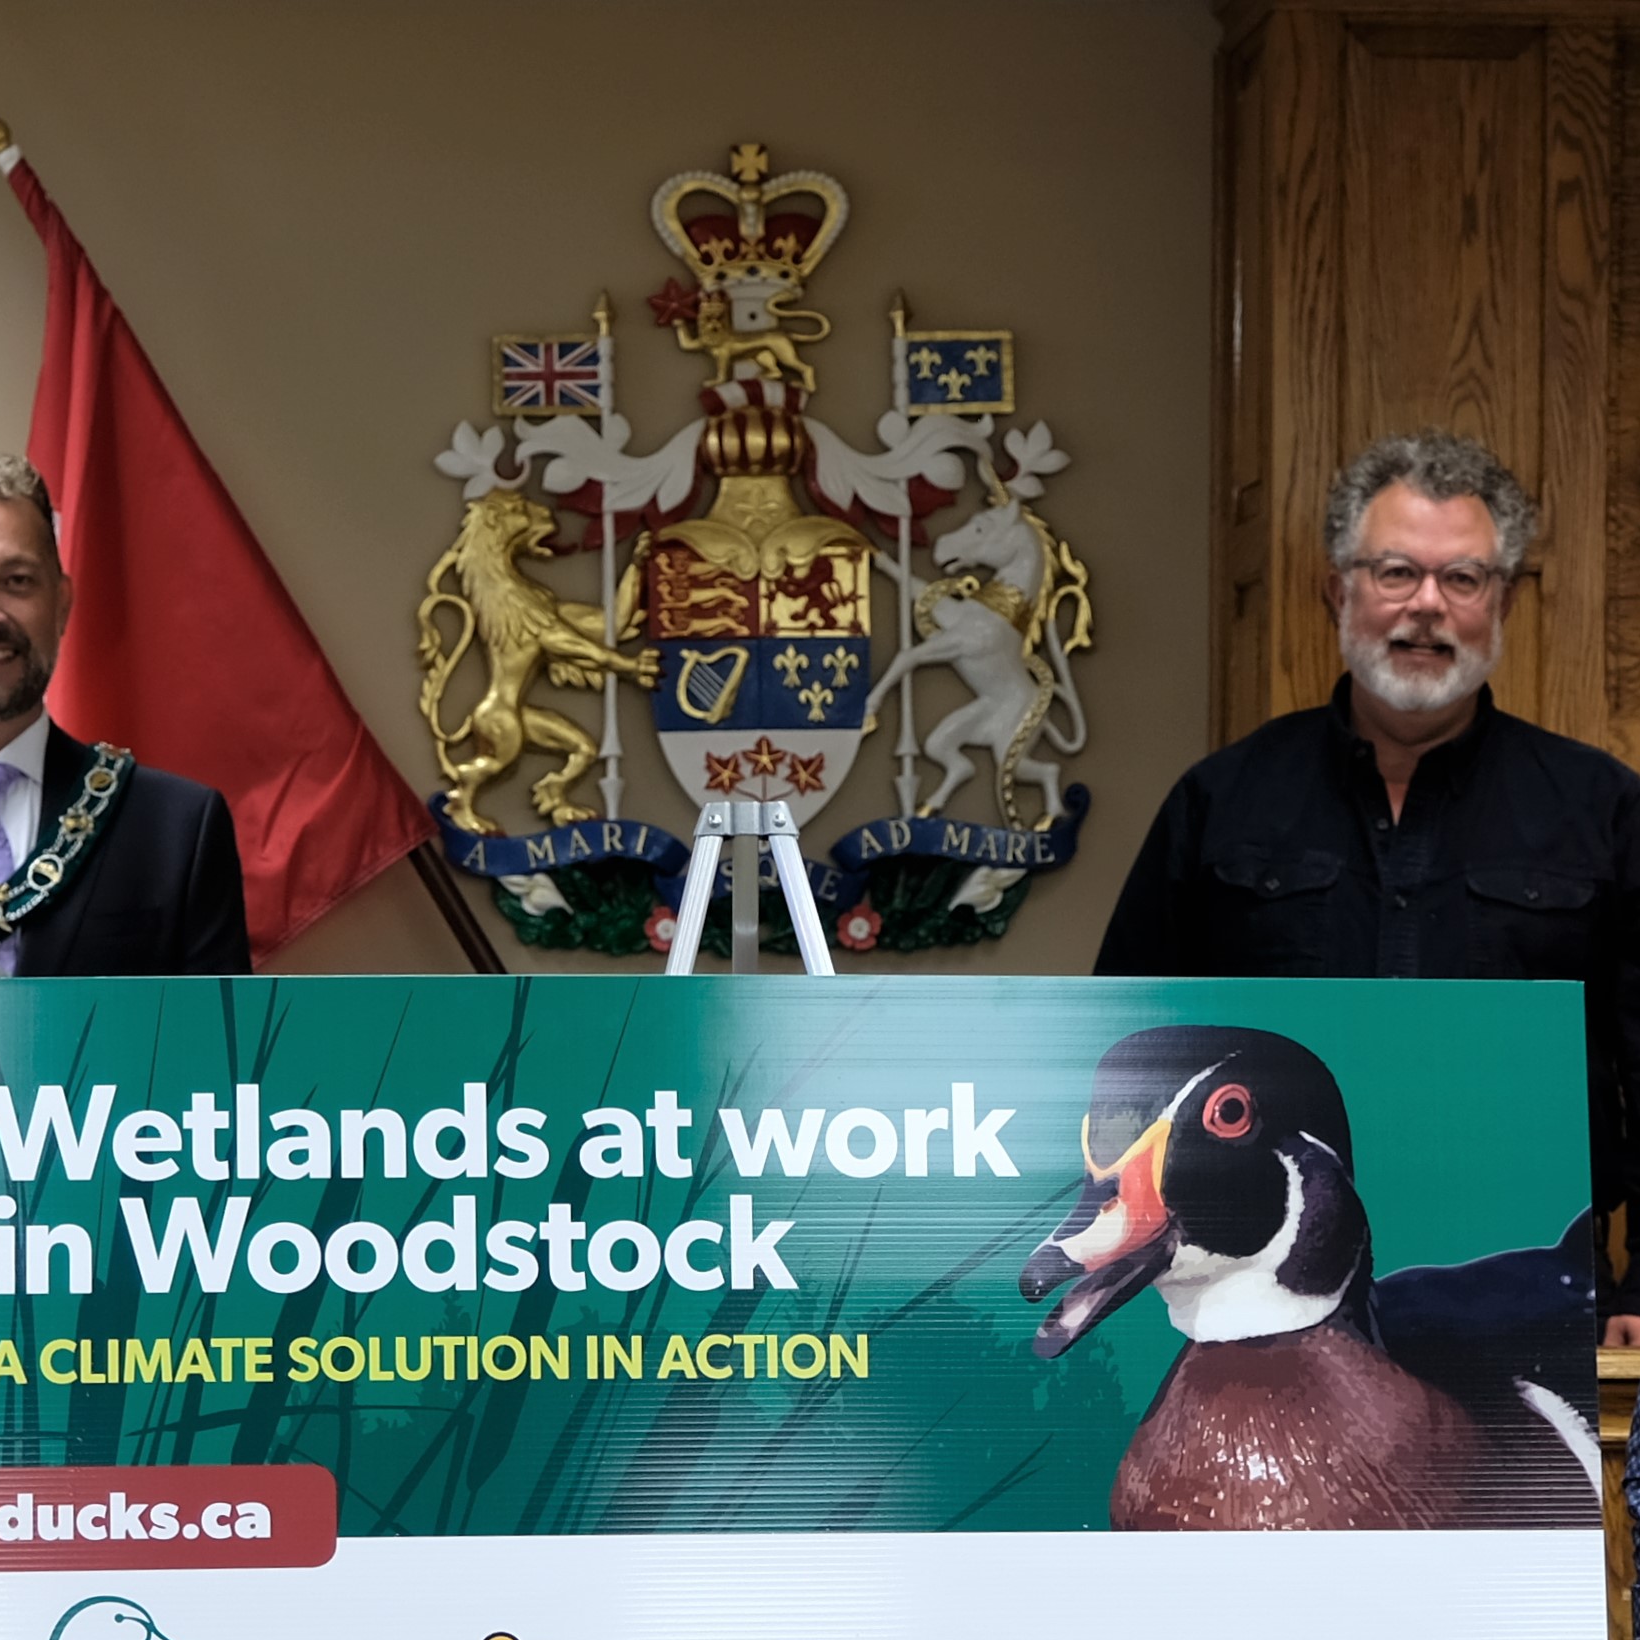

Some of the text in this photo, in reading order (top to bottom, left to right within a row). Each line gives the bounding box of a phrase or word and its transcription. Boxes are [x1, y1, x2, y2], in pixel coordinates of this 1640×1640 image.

[463, 822, 649, 872] A MARI
[860, 819, 1056, 863] AD MARE
[580, 1091, 692, 1178] at
[719, 1083, 1021, 1177] work
[119, 1195, 798, 1293] Woodstock
[40, 1337, 273, 1384] CLIMATE
[288, 1336, 570, 1382] SOLUTION
[586, 1336, 643, 1380] IN
[657, 1334, 869, 1380] ACTION
